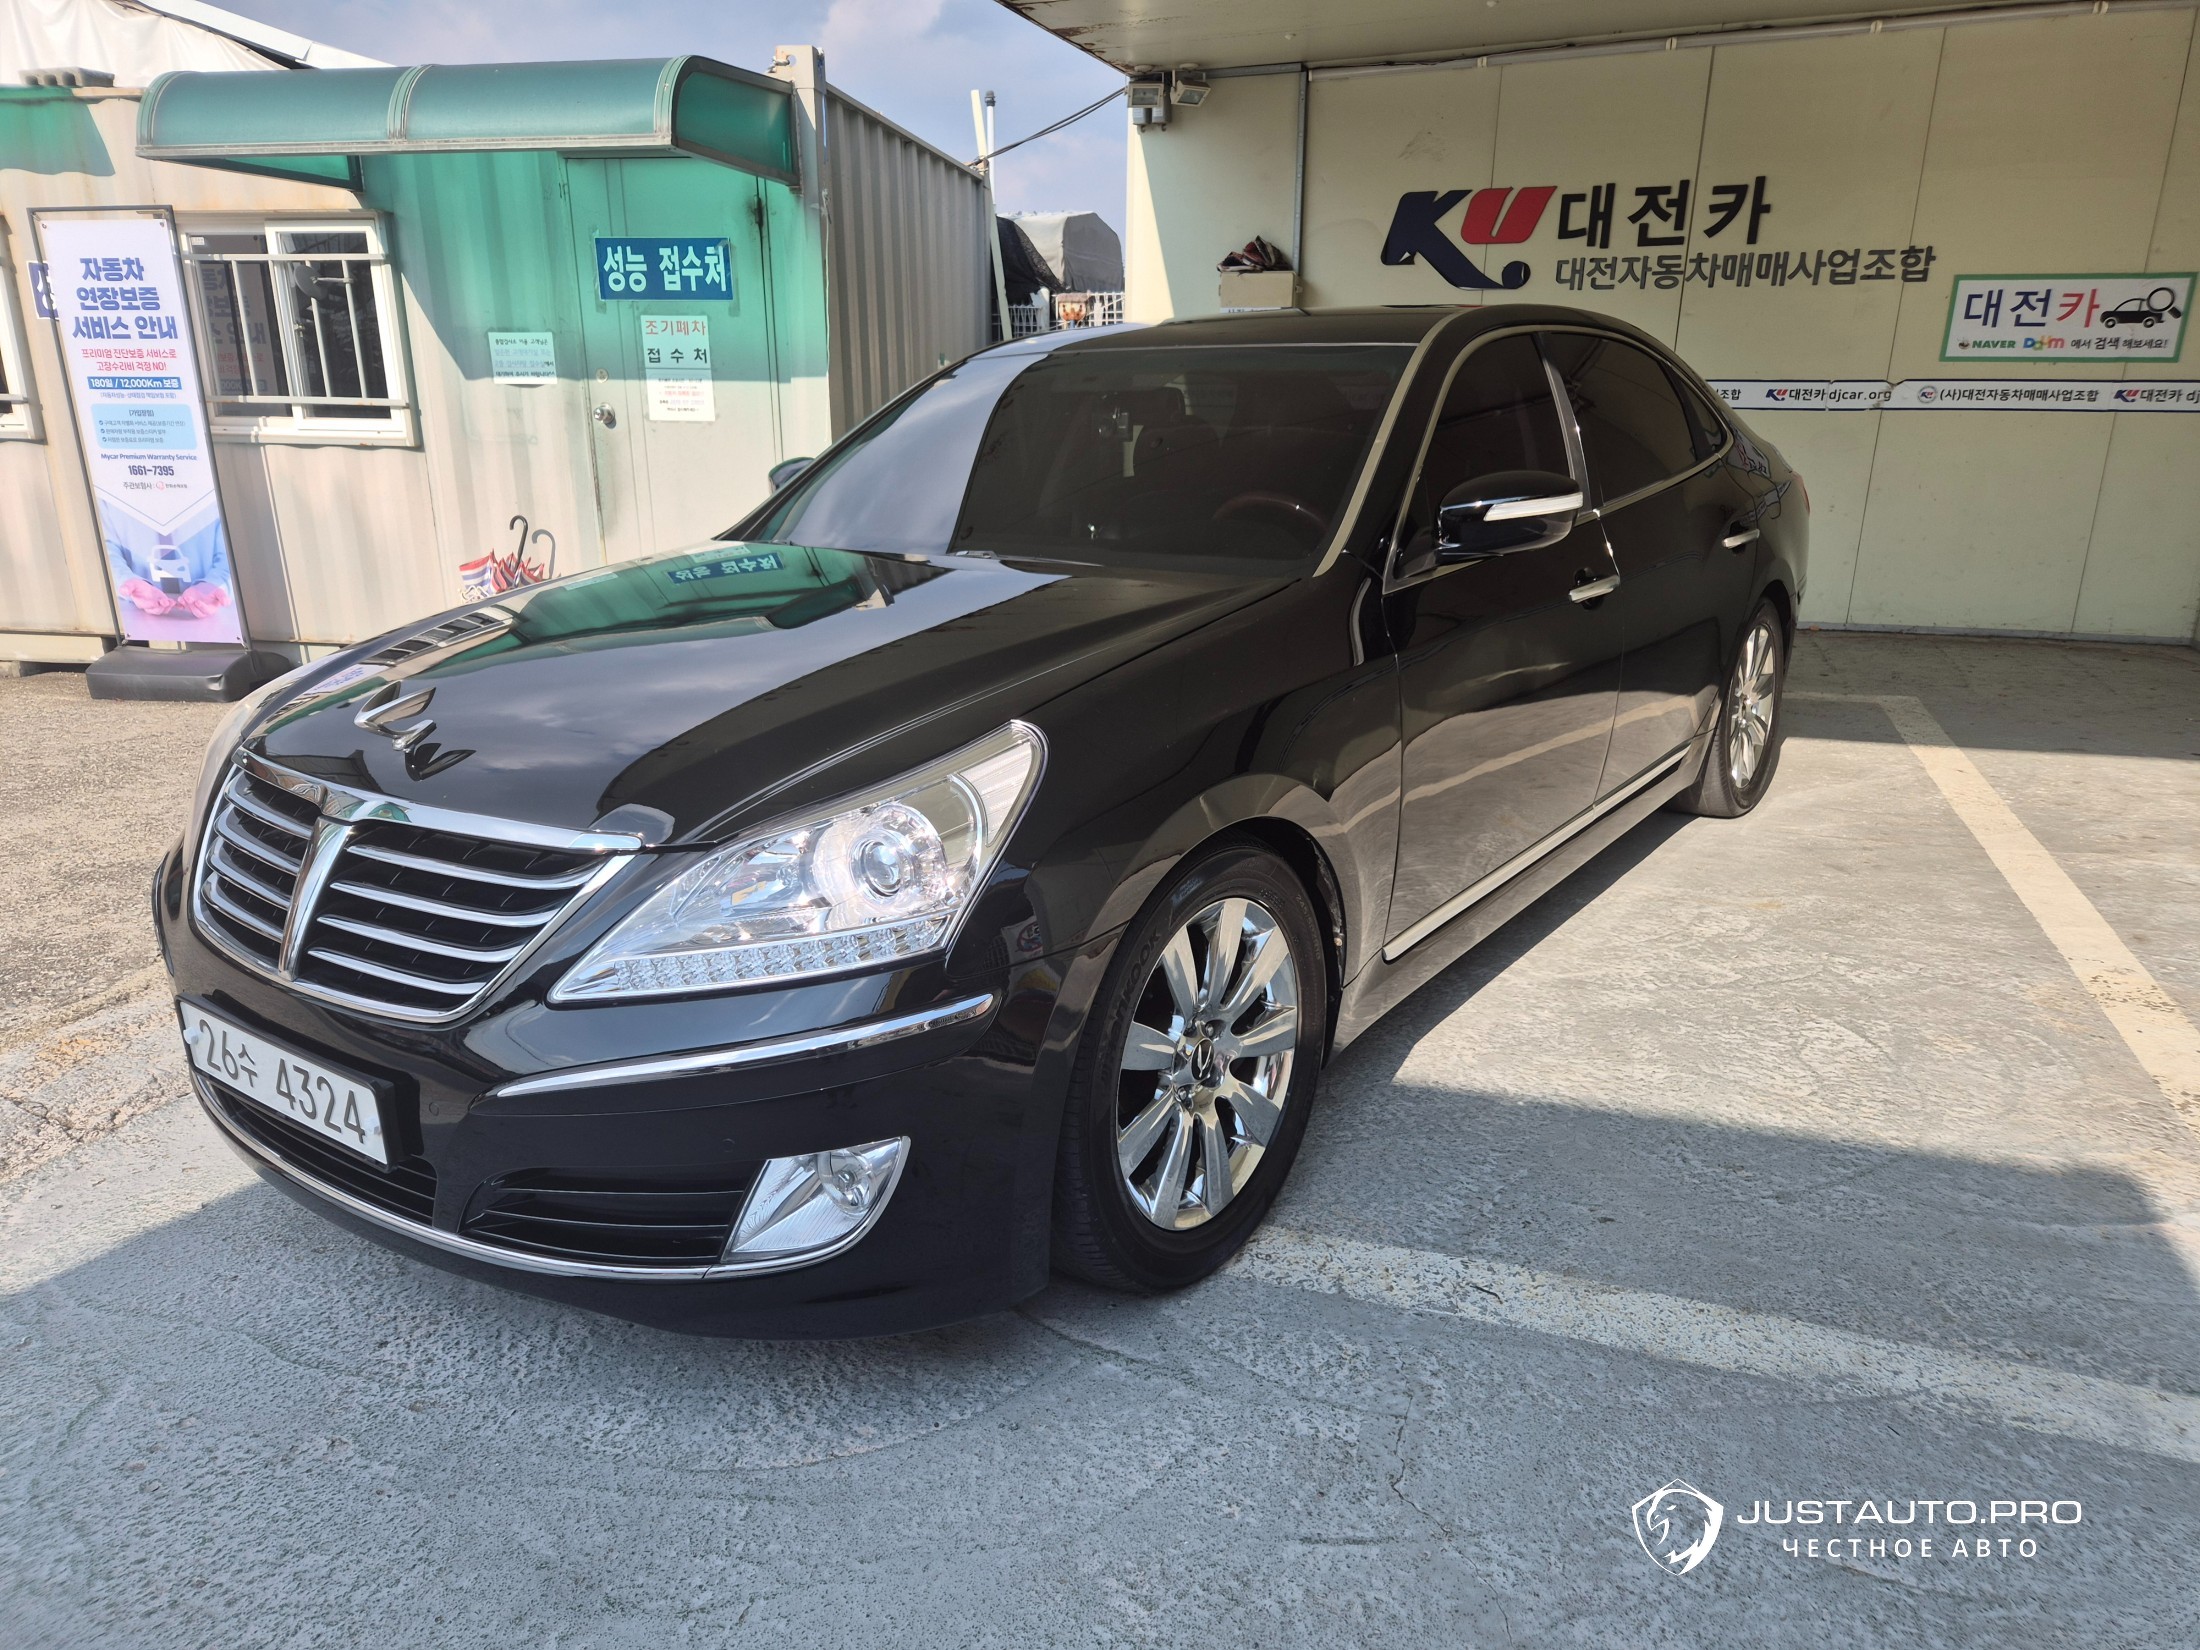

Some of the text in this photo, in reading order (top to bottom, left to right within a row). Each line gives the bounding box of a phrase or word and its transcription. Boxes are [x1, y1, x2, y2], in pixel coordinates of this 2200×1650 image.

[1557, 176, 1771, 248] 대전카
[80, 258, 144, 281] 자동차
[603, 245, 727, 292] 성능 접수처
[1556, 245, 1936, 290] 대전자동차매매사업조합
[76, 287, 160, 311] 연장보증
[1963, 288, 2100, 328] 대전카
[72, 316, 178, 340] 서비스 안내
[645, 320, 706, 336] 조기폐차
[1972, 340, 2016, 349] NAVER
[2070, 339, 2091, 349] 에서
[2094, 337, 2120, 350] 검색
[2122, 339, 2168, 349] 해보세요!
[81, 348, 177, 359] 프리미엄 진단보증 서비스로
[96, 361, 167, 371] 고장수리비 걱정 NO!
[90, 378, 113, 388] 180일
[120, 378, 162, 388] 12,000Km
[163, 379, 179, 388] 보증
[1716, 389, 1741, 401] 조합
[1789, 388, 1827, 401] 대전카
[1829, 388, 1892, 402] djcar.org
[1940, 388, 2099, 402] (사)대전자동차매매사업조합
[2140, 388, 2183, 402] 대전카
[101, 453, 118, 461] Mycar
[147, 454, 175, 462] Warranty
[128, 465, 175, 476] 1661-7395
[199, 1018, 366, 1144] 26수 4324
